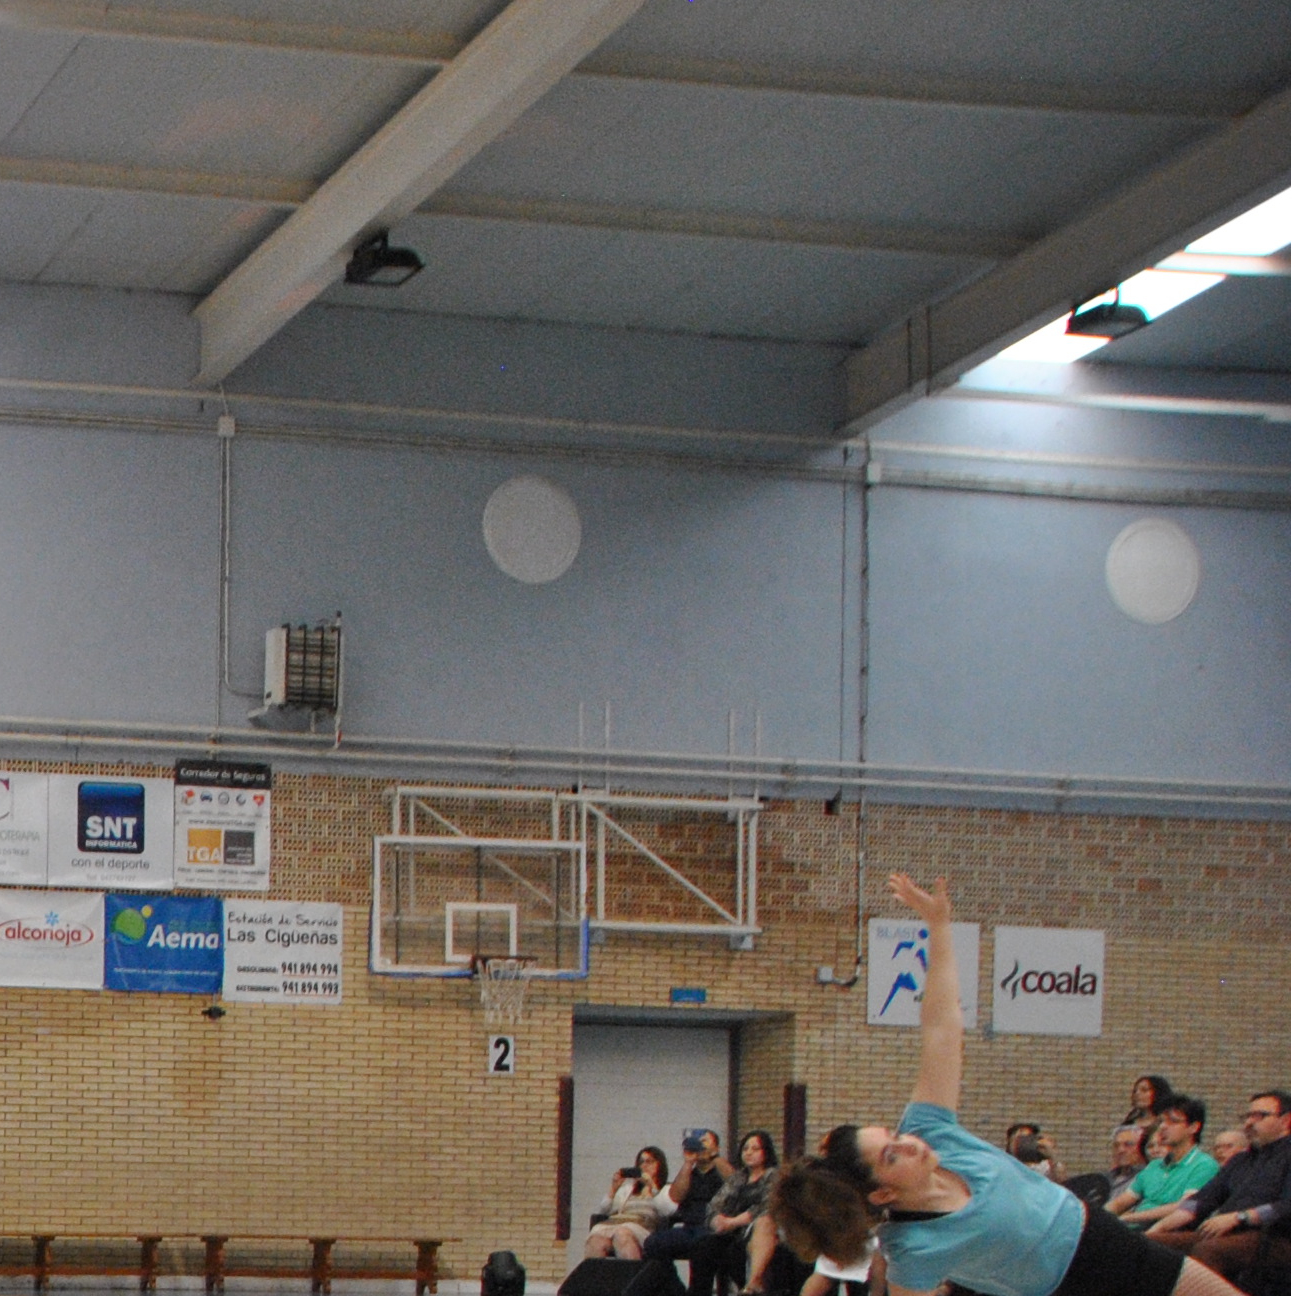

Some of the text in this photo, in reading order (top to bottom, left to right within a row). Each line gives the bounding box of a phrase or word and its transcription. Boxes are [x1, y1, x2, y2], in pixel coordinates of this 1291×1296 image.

[180, 768, 266, 783] Corredor de Seguros
[85, 815, 137, 839] SNT
[187, 846, 221, 861] TGA
[71, 857, 150, 871] con el deporte
[279, 914, 290, 925] de
[295, 914, 338, 927] Servicio
[146, 924, 219, 949] Aema
[227, 928, 338, 948] Las Cigüeñas
[281, 961, 297, 974] 941
[300, 962, 317, 975] 894
[321, 963, 338, 976] 994
[1021, 963, 1097, 996] coala
[282, 981, 298, 994] 941
[301, 982, 318, 994] 894
[322, 982, 338, 995] 993
[494, 1037, 510, 1071] 2
